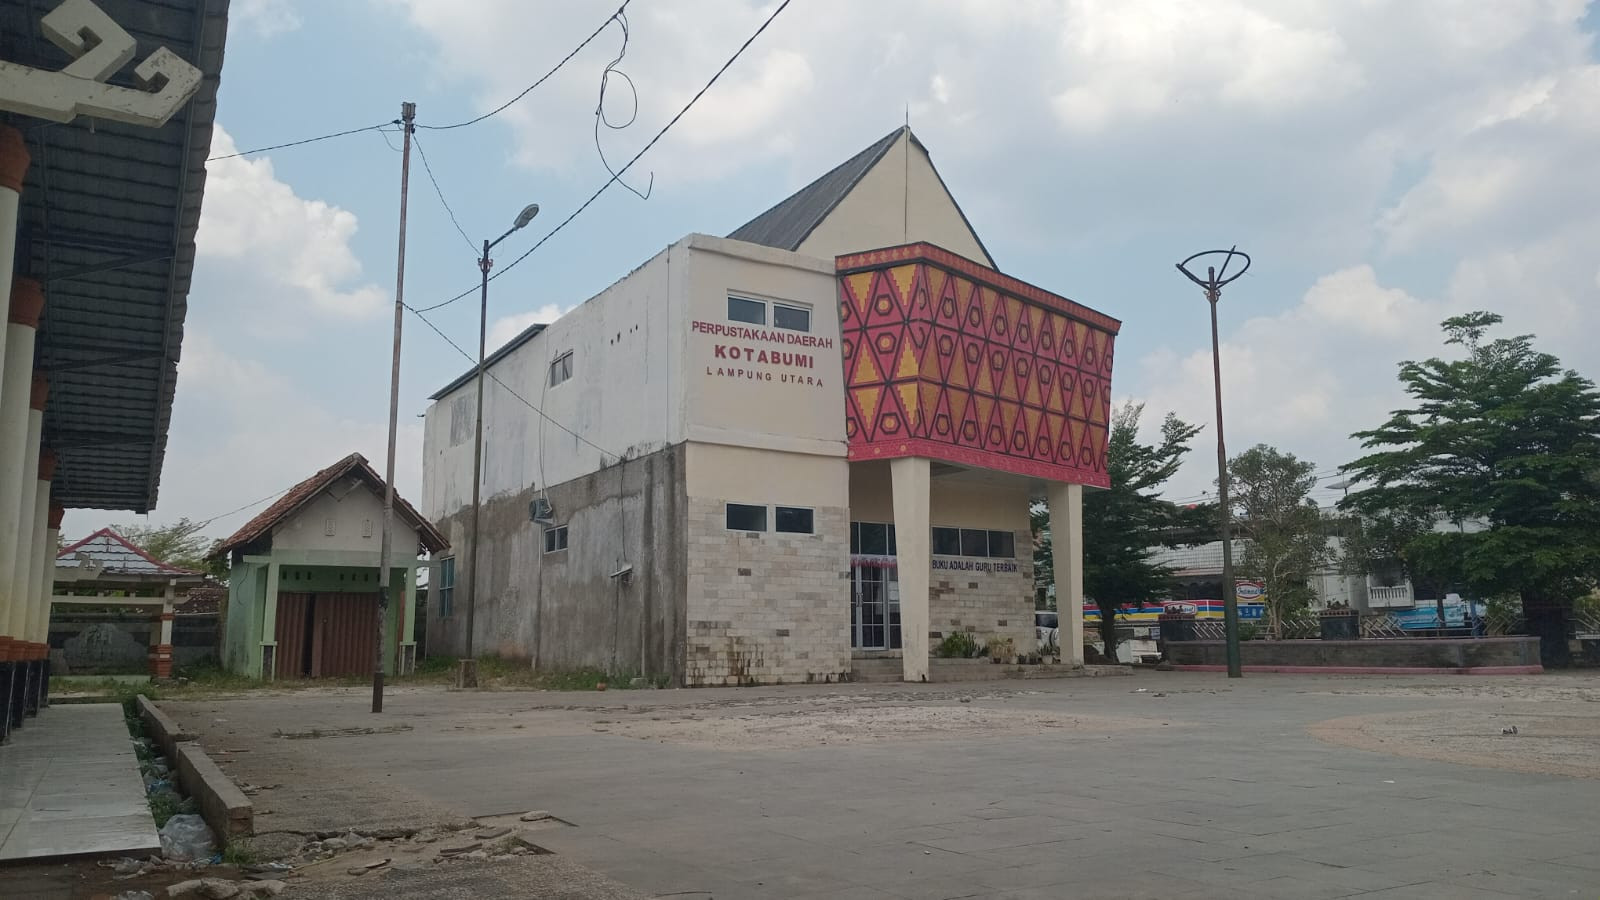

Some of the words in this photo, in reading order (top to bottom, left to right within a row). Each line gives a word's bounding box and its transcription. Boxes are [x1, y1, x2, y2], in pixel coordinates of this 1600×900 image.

[692, 320, 785, 344] PERPUSTAKAAN
[787, 333, 833, 349] DAERAH
[714, 344, 814, 369] KOTABUMI
[706, 366, 772, 381] LAMPUNG
[781, 374, 823, 388] UTARA
[932, 559, 948, 570] BUKU
[949, 560, 974, 571] ADALAH
[975, 562, 992, 572] GURU
[993, 562, 1018, 573] TERBAIK
